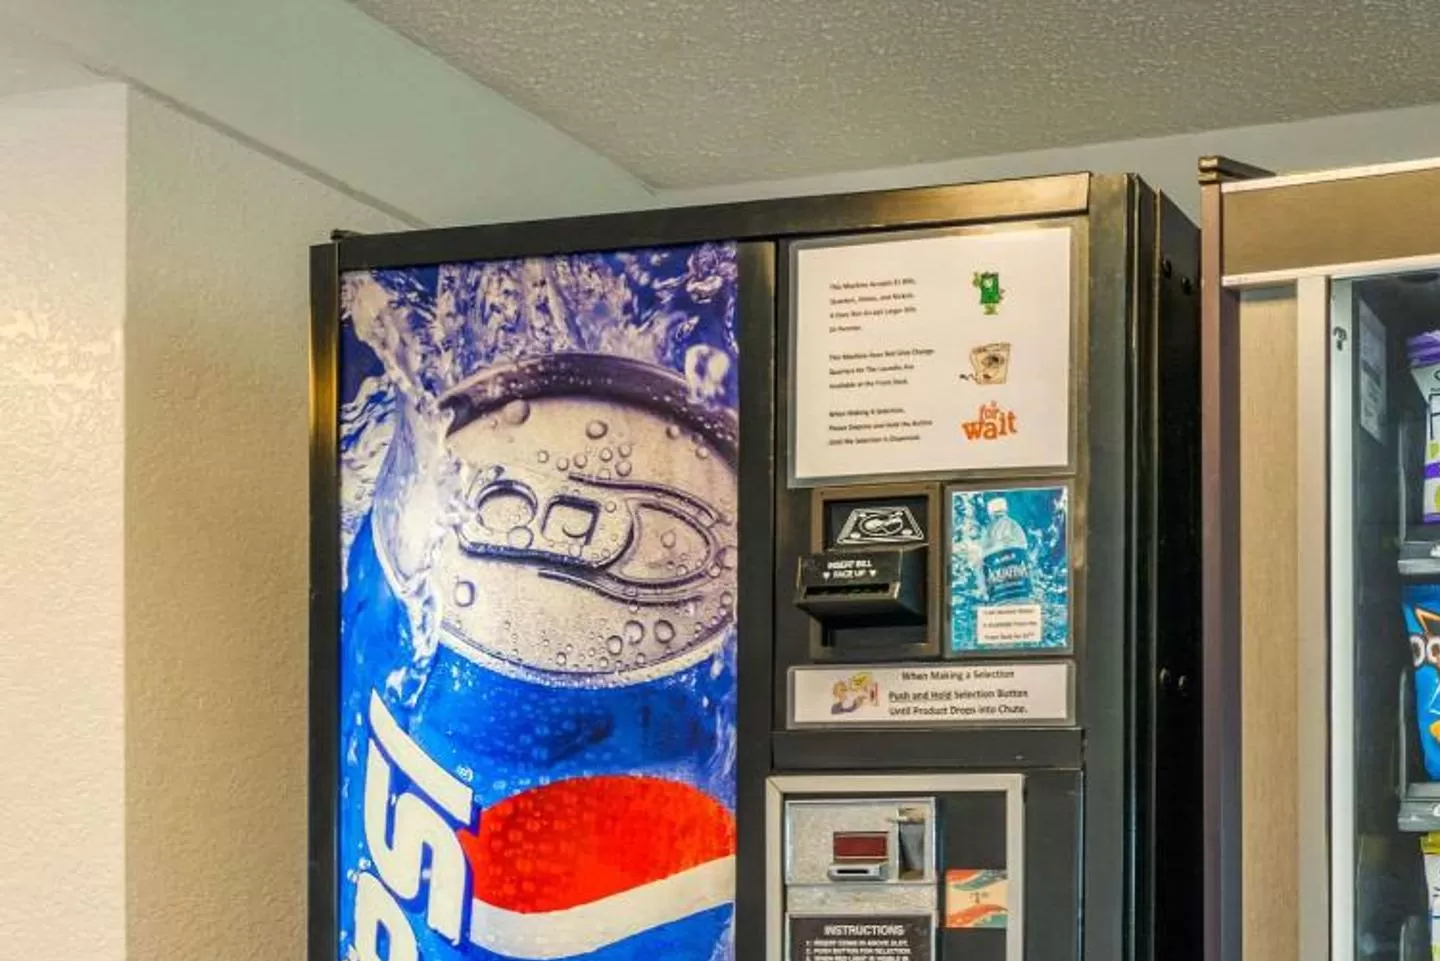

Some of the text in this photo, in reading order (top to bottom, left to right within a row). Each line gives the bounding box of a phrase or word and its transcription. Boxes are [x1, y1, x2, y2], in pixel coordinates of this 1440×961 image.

[962, 411, 1018, 440] wait
[902, 672, 928, 680] When
[930, 671, 963, 681] Making
[973, 670, 1014, 679] Selection
[889, 689, 1028, 700] Push and Hold Selection Button
[913, 706, 948, 715] Product
[823, 924, 905, 936] INSTRUCTIONS
